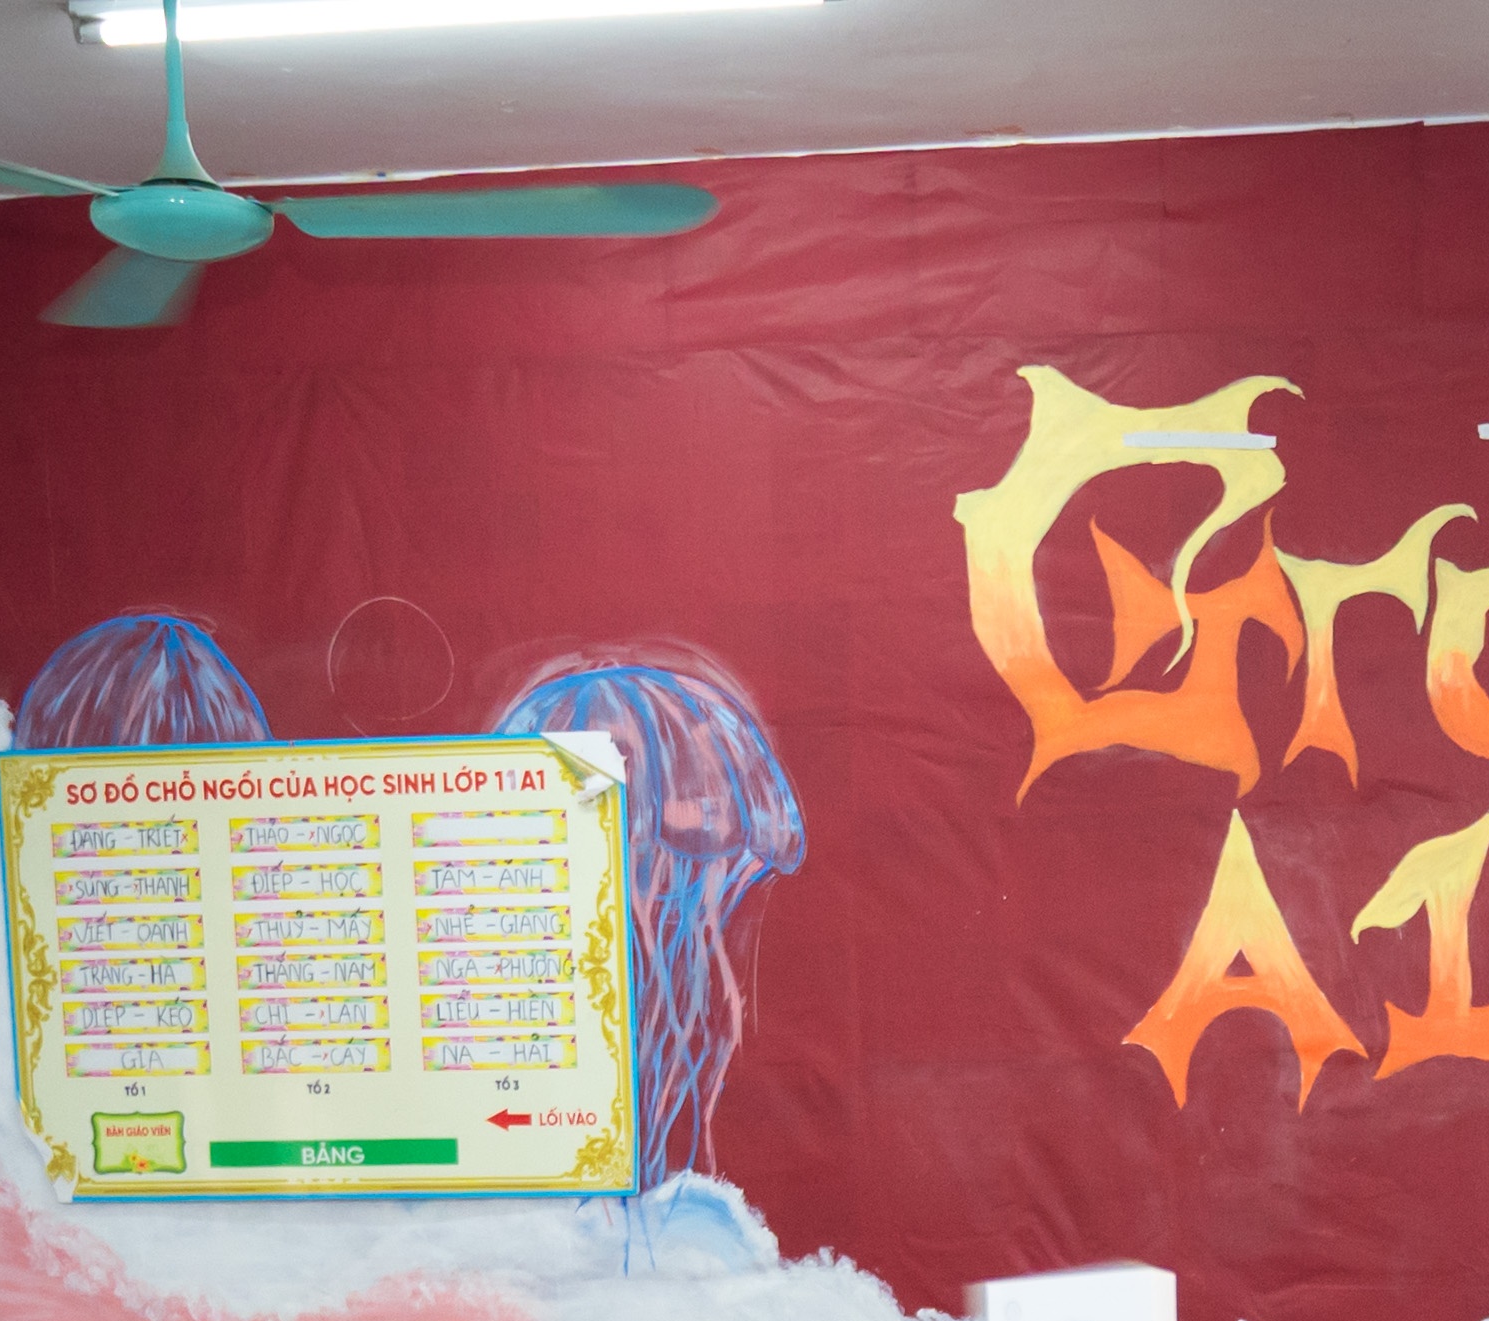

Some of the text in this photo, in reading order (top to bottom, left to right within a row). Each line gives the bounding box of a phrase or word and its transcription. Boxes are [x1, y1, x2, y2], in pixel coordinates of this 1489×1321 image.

[67, 781, 98, 805] SƠ
[104, 774, 139, 804] ĐỒ
[146, 770, 196, 802] CHỖ
[203, 770, 262, 800] NGỒI
[269, 770, 317, 798] CỦA
[325, 775, 375, 803] HỌC
[383, 773, 435, 795] SINH
[443, 766, 488, 793] LỚP
[500, 913, 565, 935] GIANG
[334, 962, 376, 982] NAM
[436, 958, 479, 979] NGA
[121, 1050, 165, 1071] GIA
[443, 1045, 474, 1065] NA
[324, 1084, 331, 1094] 2
[539, 1108, 597, 1126] LỐI VÀO
[301, 1142, 365, 1165] BẢNG
